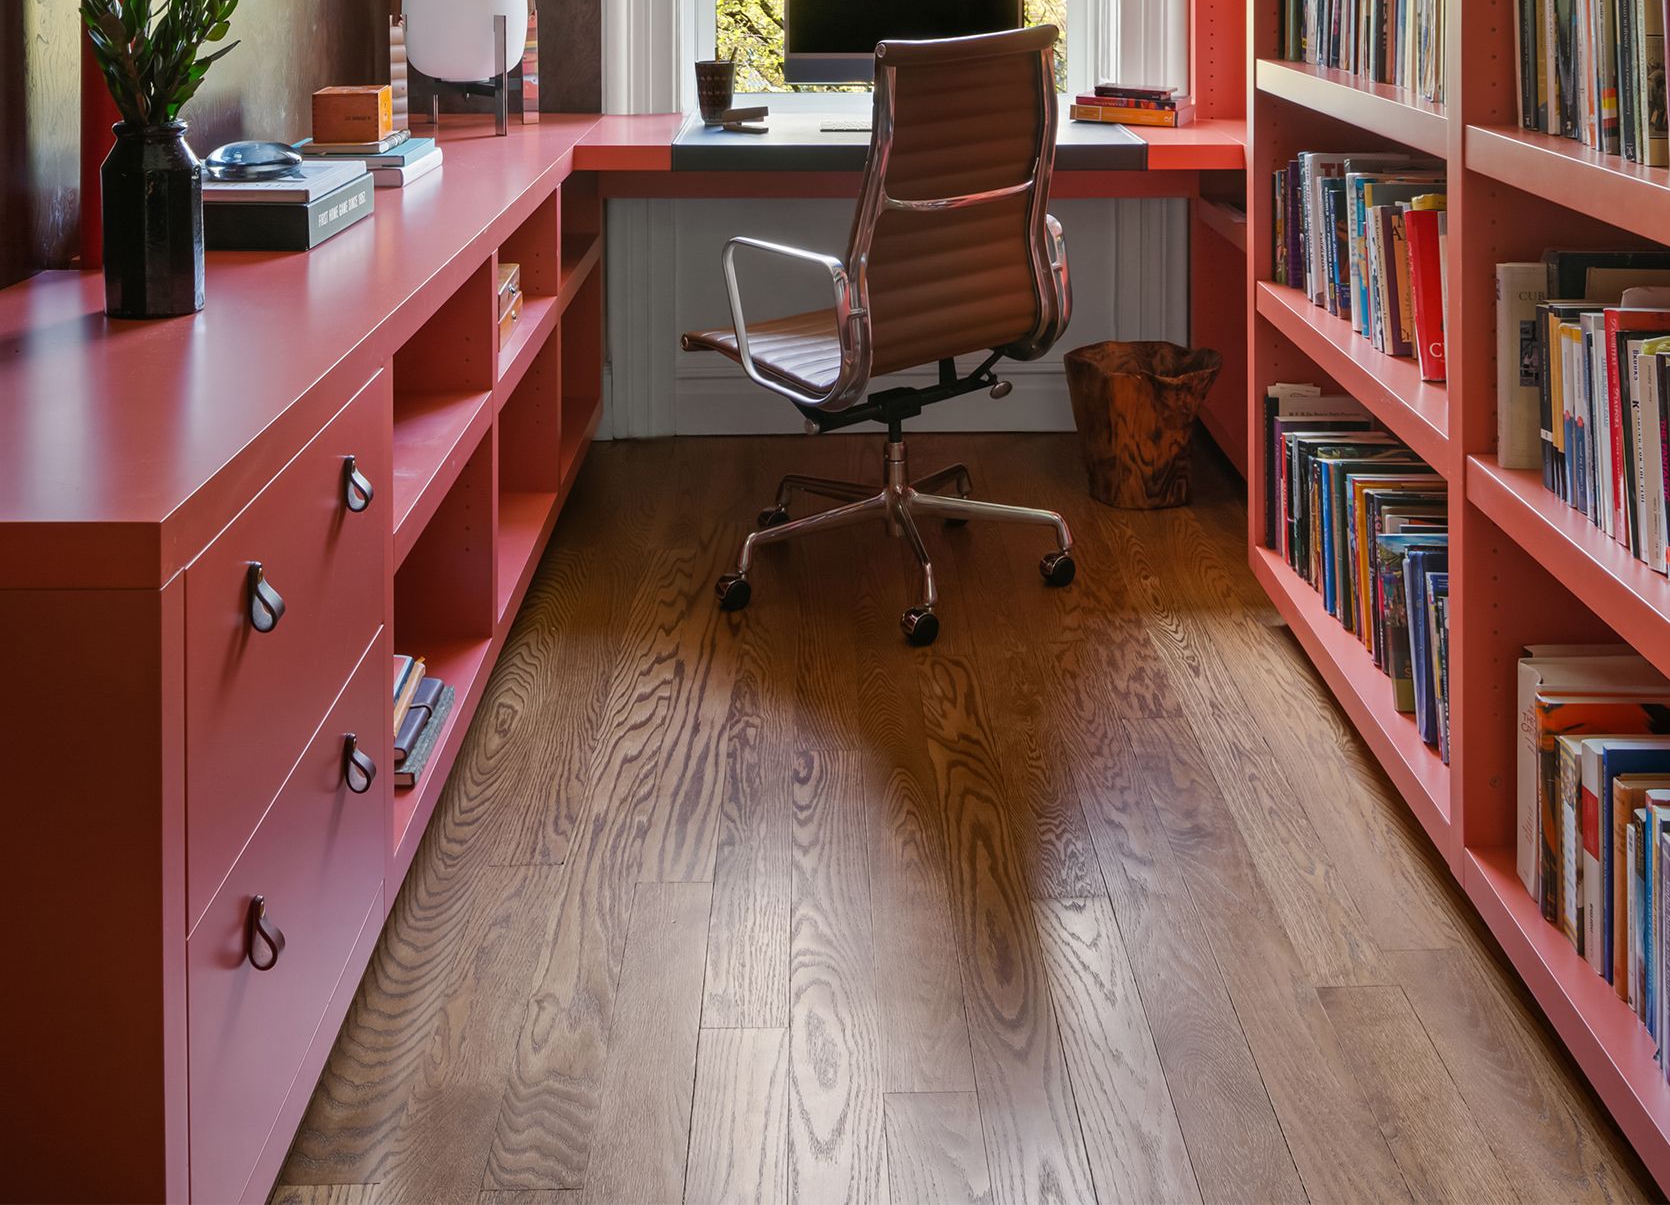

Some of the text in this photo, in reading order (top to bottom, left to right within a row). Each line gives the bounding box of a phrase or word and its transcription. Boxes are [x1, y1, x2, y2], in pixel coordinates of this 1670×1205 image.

[318, 210, 329, 228] FIRST
[329, 205, 339, 222] HOME
[339, 200, 349, 217] GAME
[348, 195, 358, 211] SINCE
[1518, 291, 1545, 301] CUB
